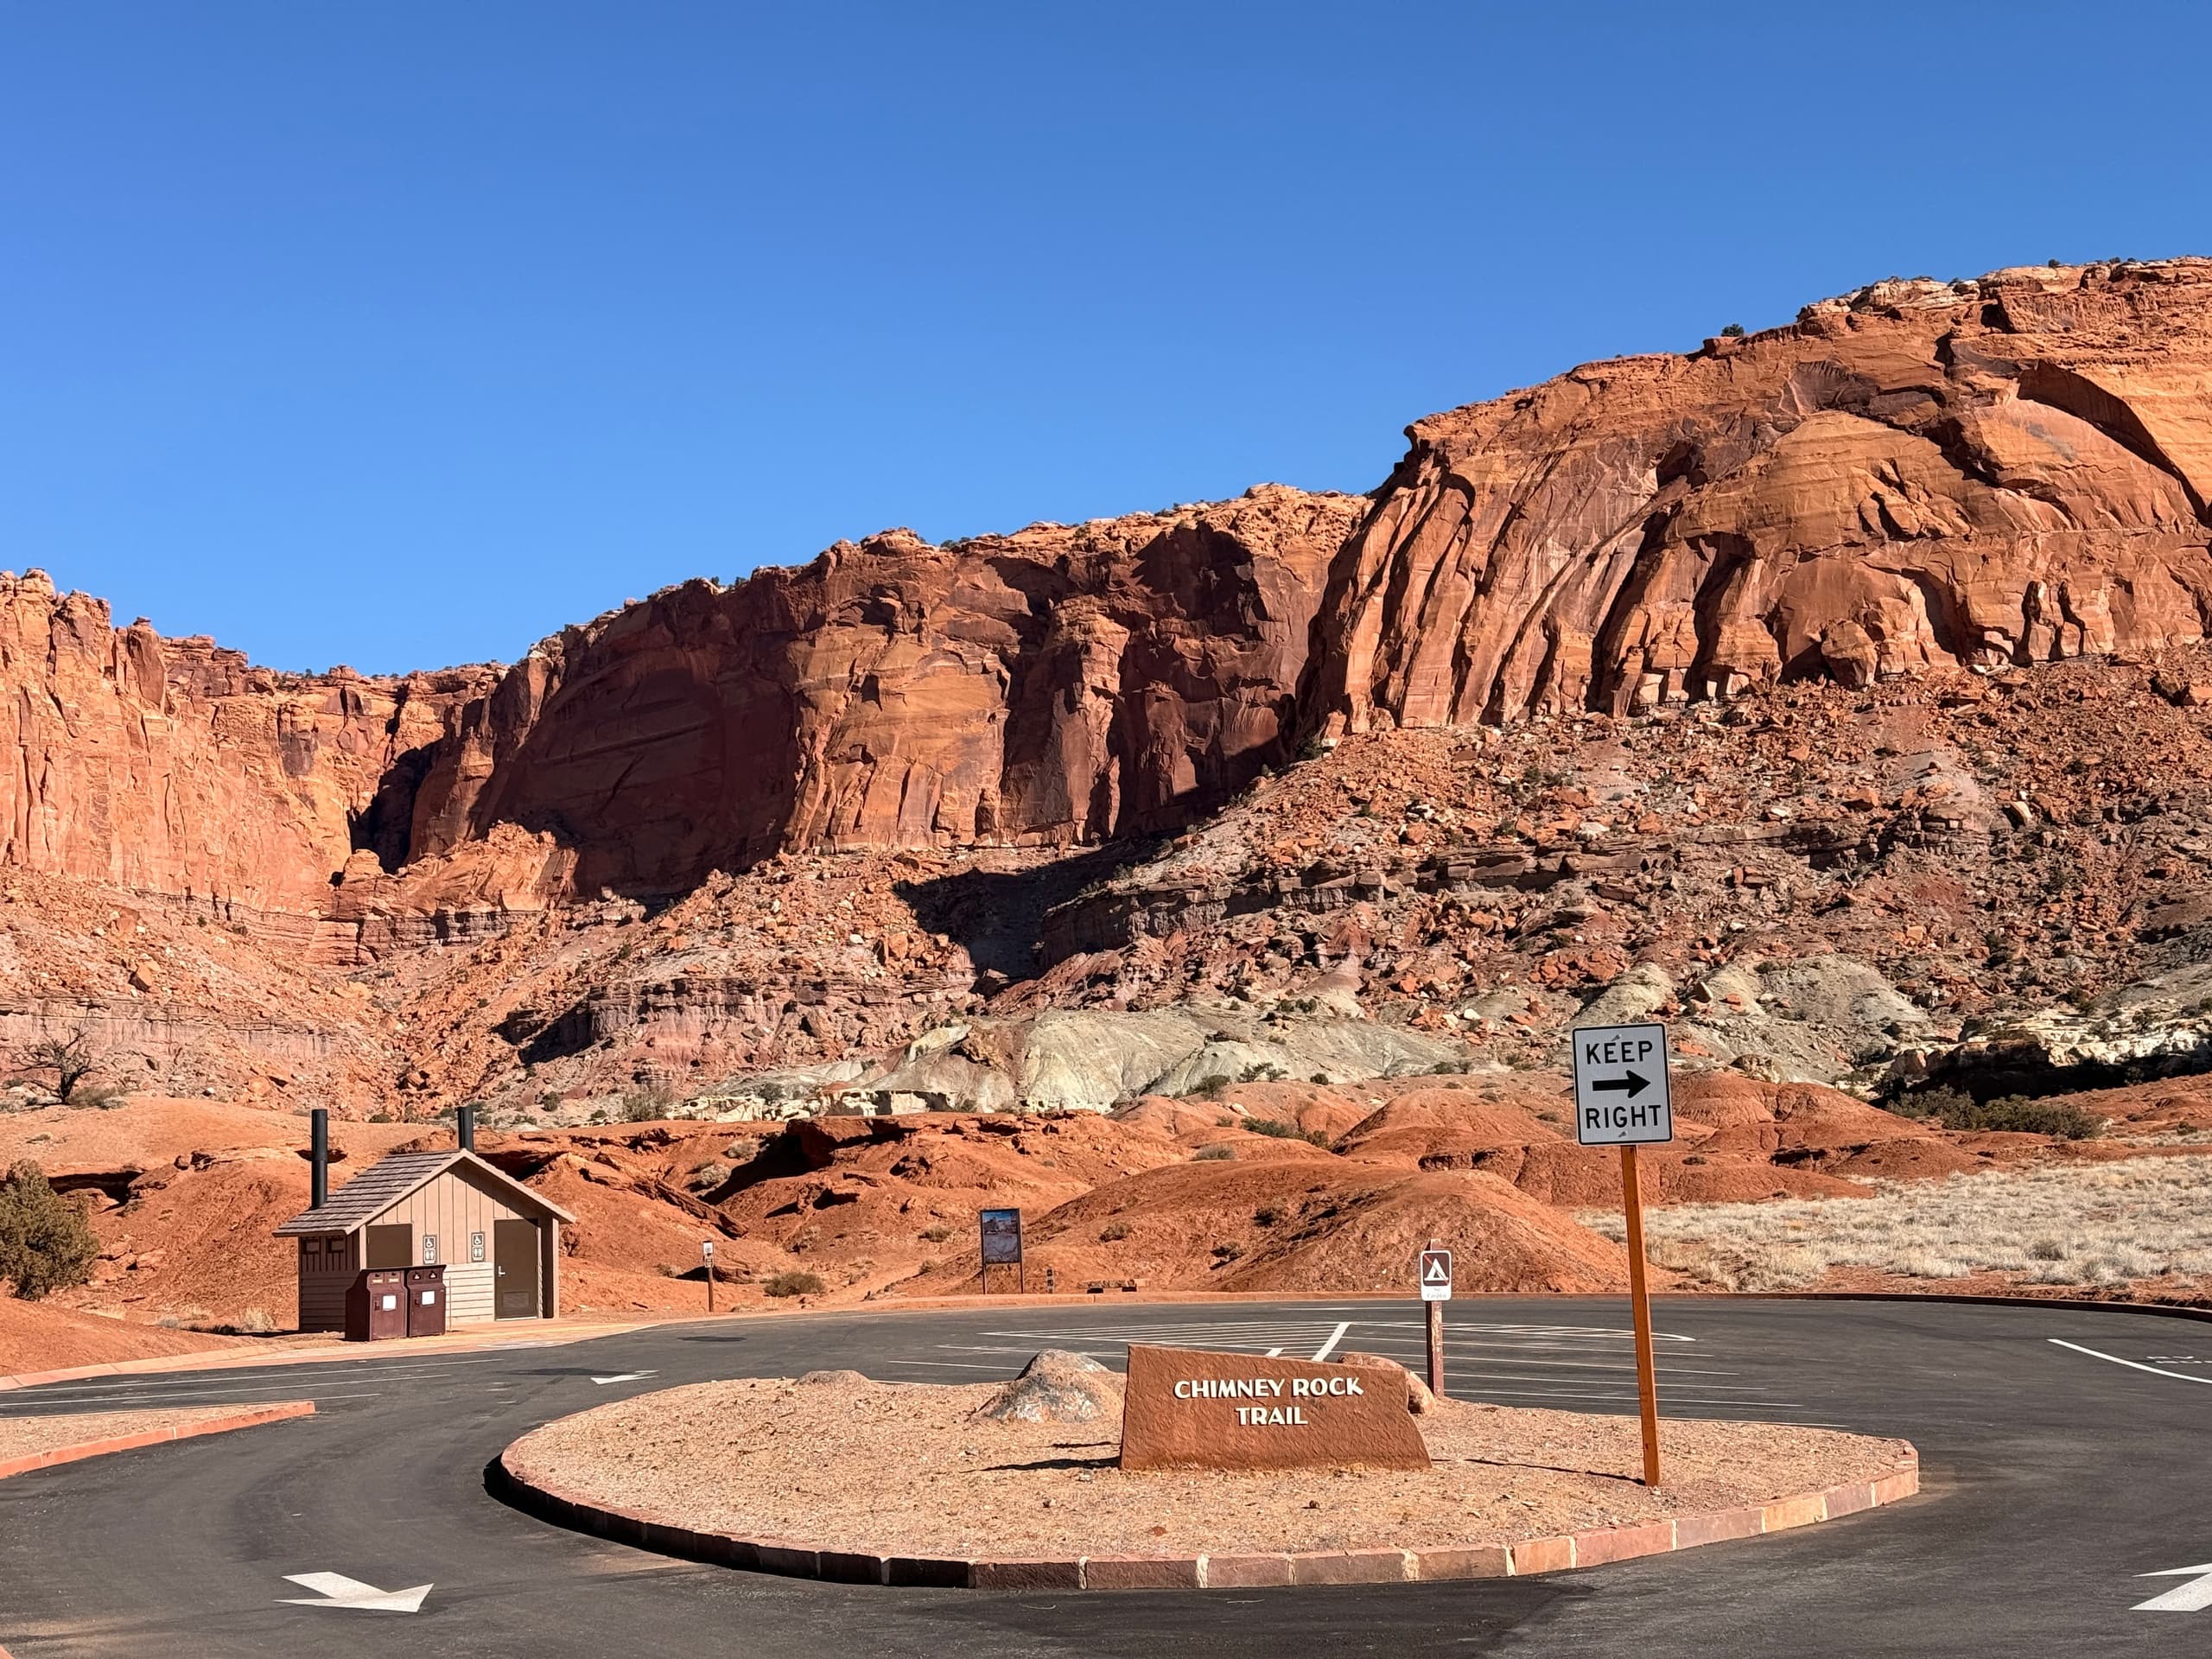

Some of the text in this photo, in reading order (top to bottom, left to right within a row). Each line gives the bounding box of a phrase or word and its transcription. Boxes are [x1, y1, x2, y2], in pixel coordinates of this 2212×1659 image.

[1586, 1040, 1653, 1065] KEEP
[1586, 1105, 1662, 1129] RIGHT
[1174, 1377, 1364, 1399] CHIMNEY ROCK
[1236, 1407, 1308, 1426] TRAIL
